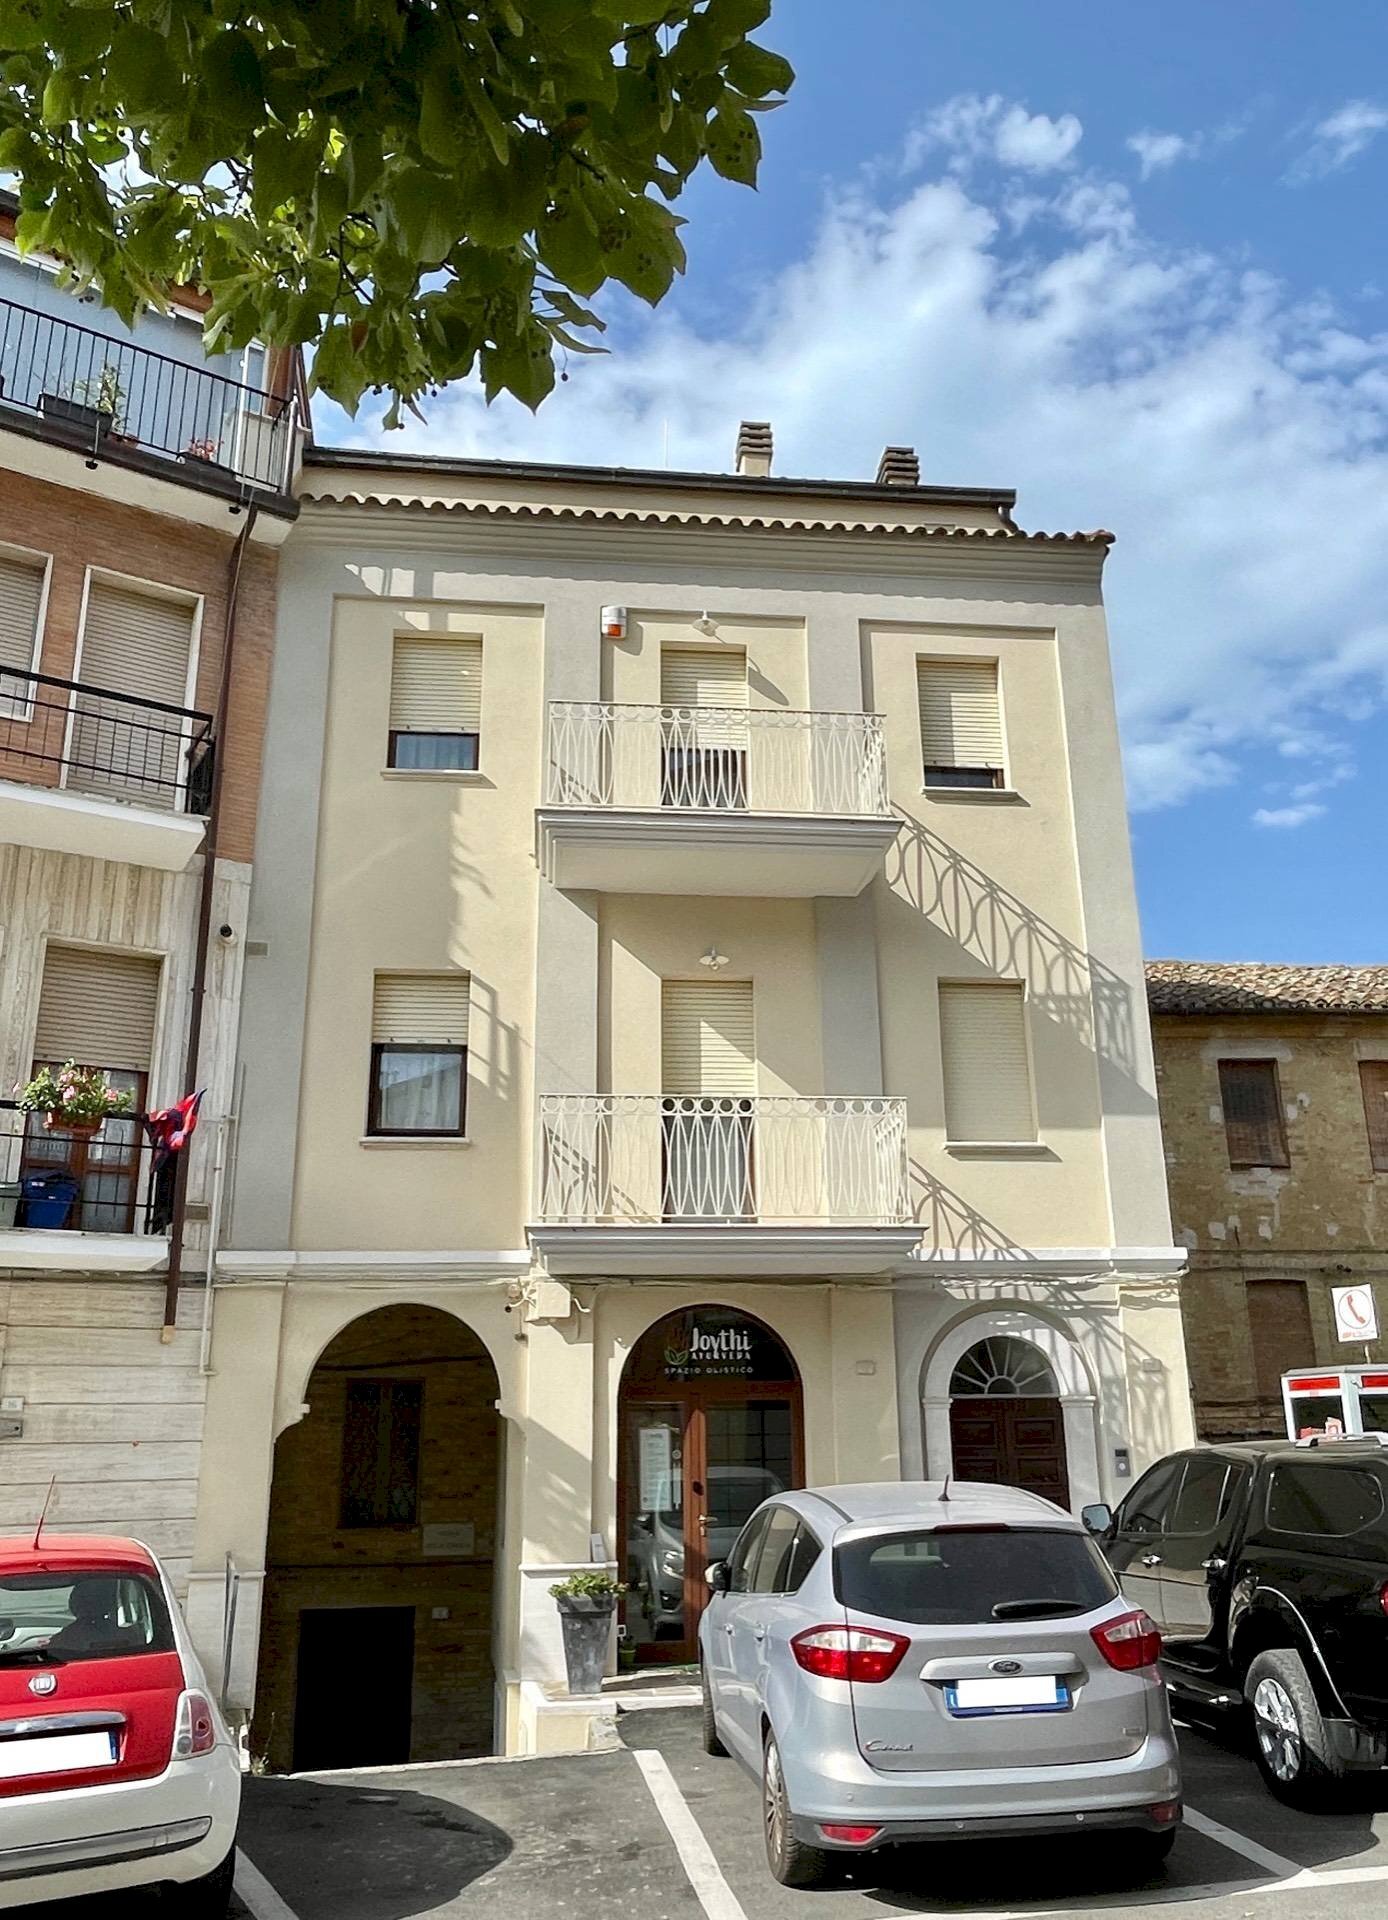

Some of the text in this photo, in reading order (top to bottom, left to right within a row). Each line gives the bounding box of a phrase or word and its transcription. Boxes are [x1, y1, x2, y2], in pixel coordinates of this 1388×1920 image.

[689, 1327, 753, 1355] Joythi
[691, 1351, 751, 1360] AYURVEDA
[664, 1366, 754, 1375] SPAZIO OLISTICO
